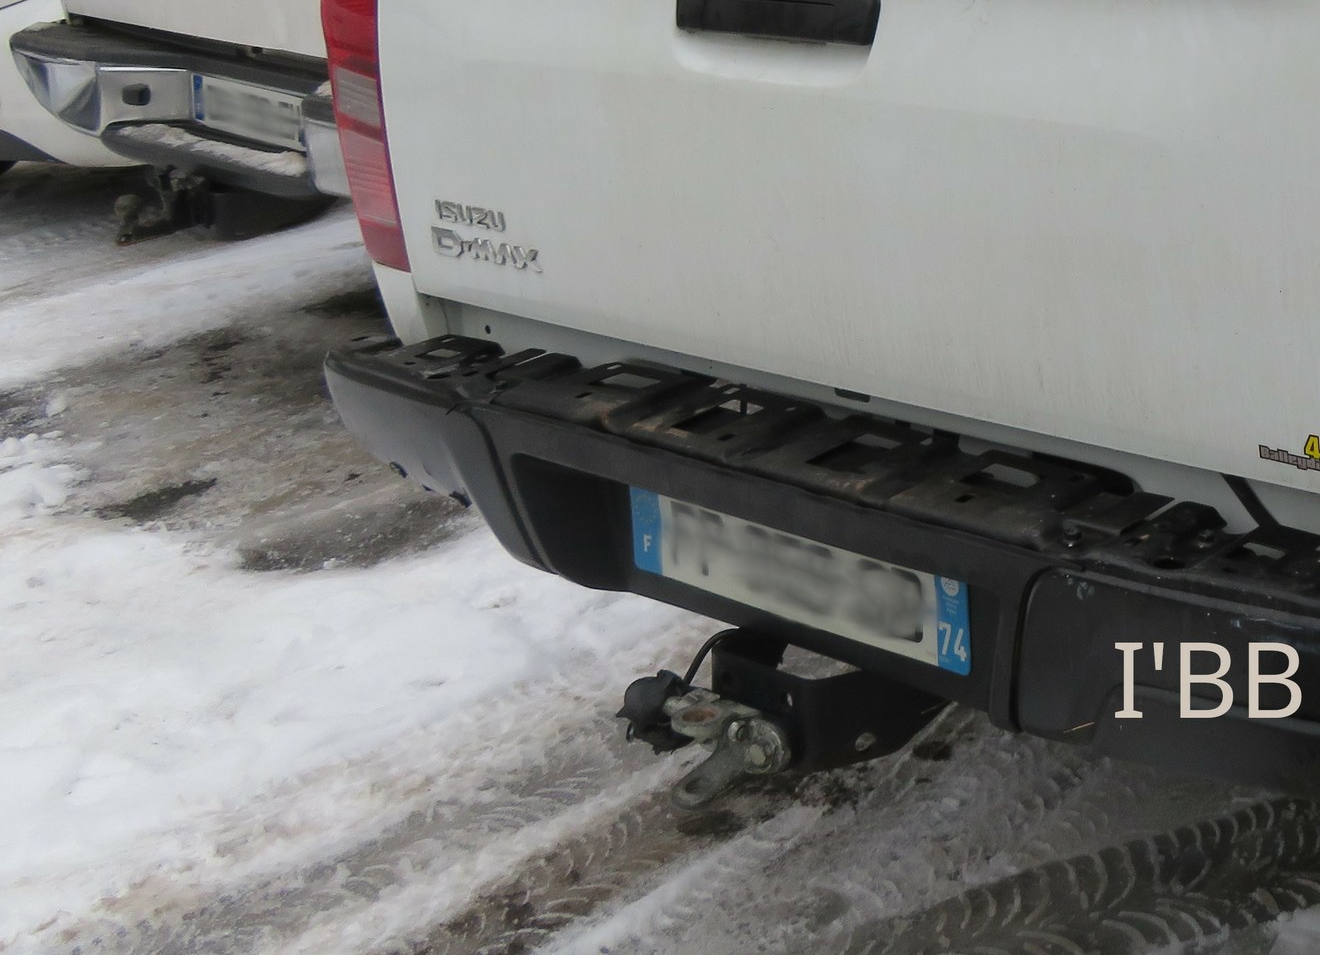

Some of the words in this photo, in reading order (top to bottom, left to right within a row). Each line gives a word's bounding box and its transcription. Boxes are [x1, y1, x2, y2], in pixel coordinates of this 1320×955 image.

[434, 199, 506, 232] ISUZU
[430, 226, 544, 274] D-MAX
[643, 534, 653, 553] F
[938, 621, 967, 662] 74
